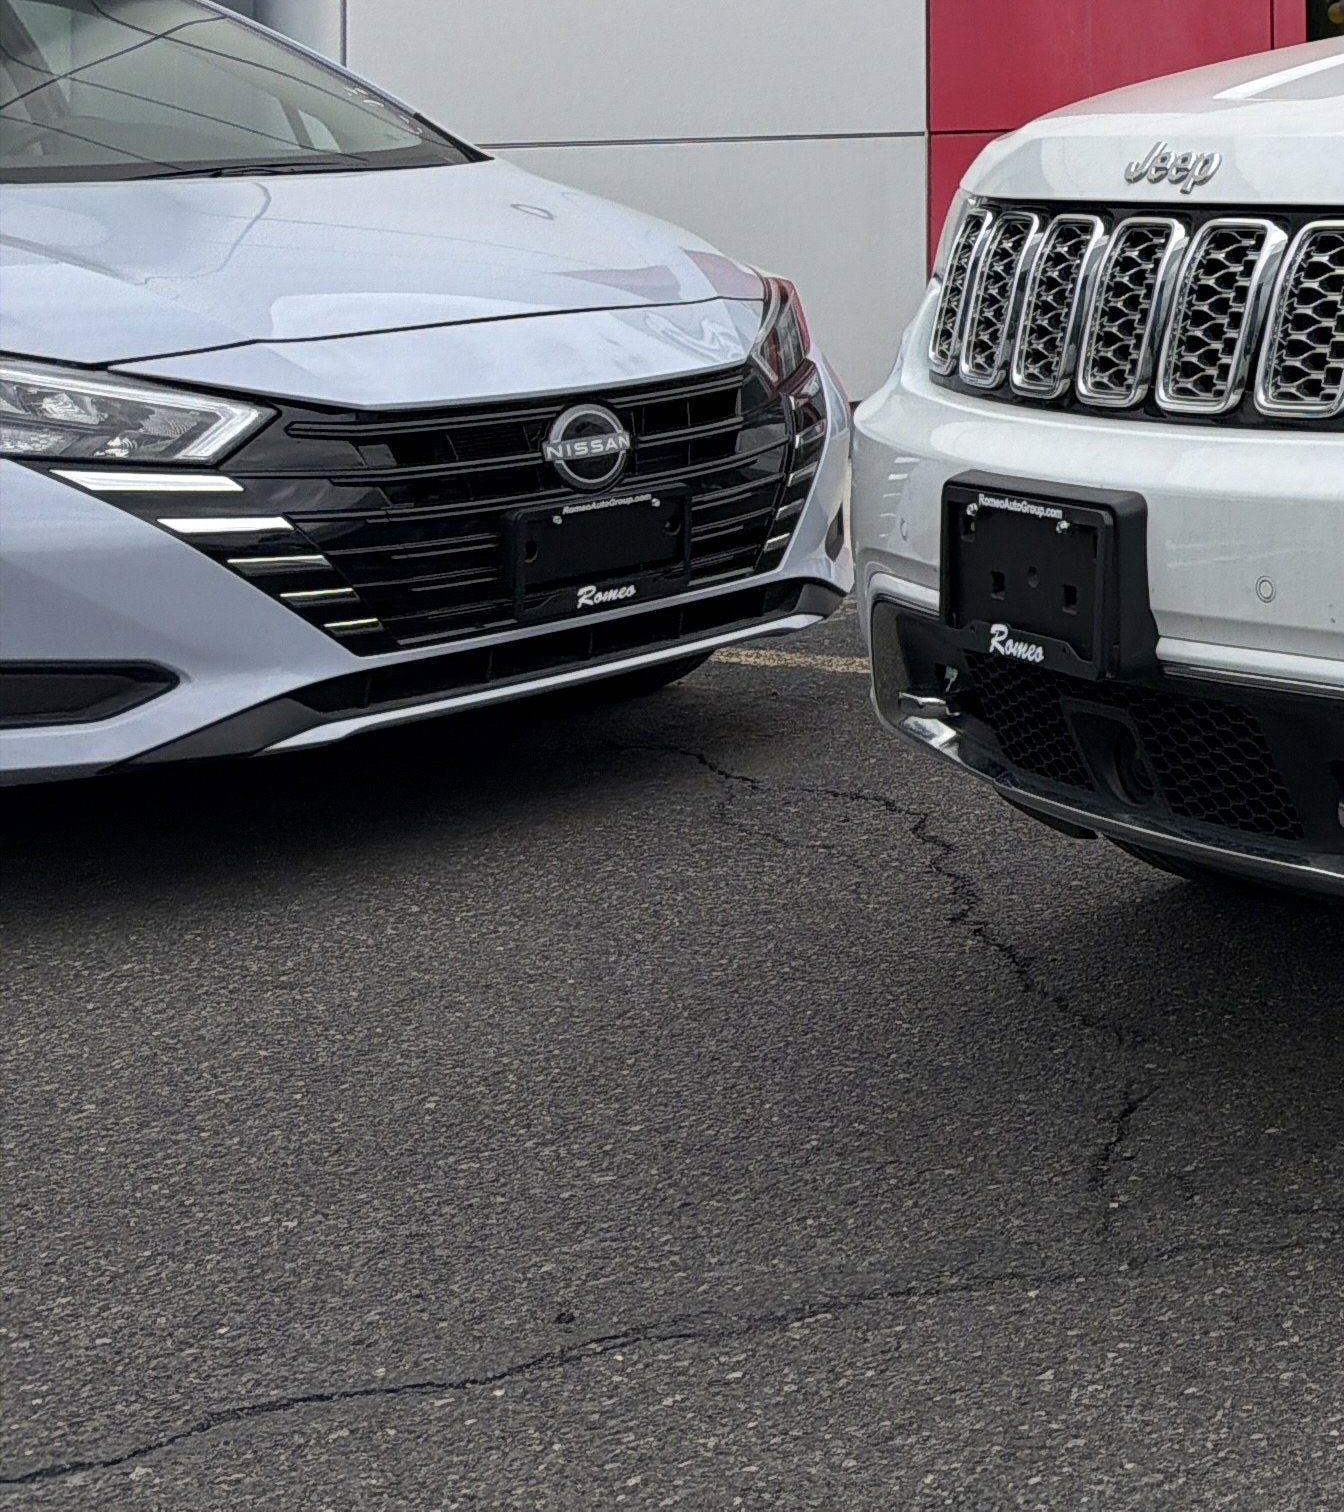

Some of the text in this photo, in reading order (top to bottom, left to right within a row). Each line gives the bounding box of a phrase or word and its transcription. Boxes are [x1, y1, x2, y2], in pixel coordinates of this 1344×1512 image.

[1124, 140, 1223, 195] Jeep
[546, 434, 630, 460] NISSAN
[562, 492, 653, 516] RomeoAutoGroup.com
[978, 492, 1064, 520] RomeoAutoGroup.com
[576, 584, 637, 609] Romeo
[989, 623, 1045, 663] Romeo
